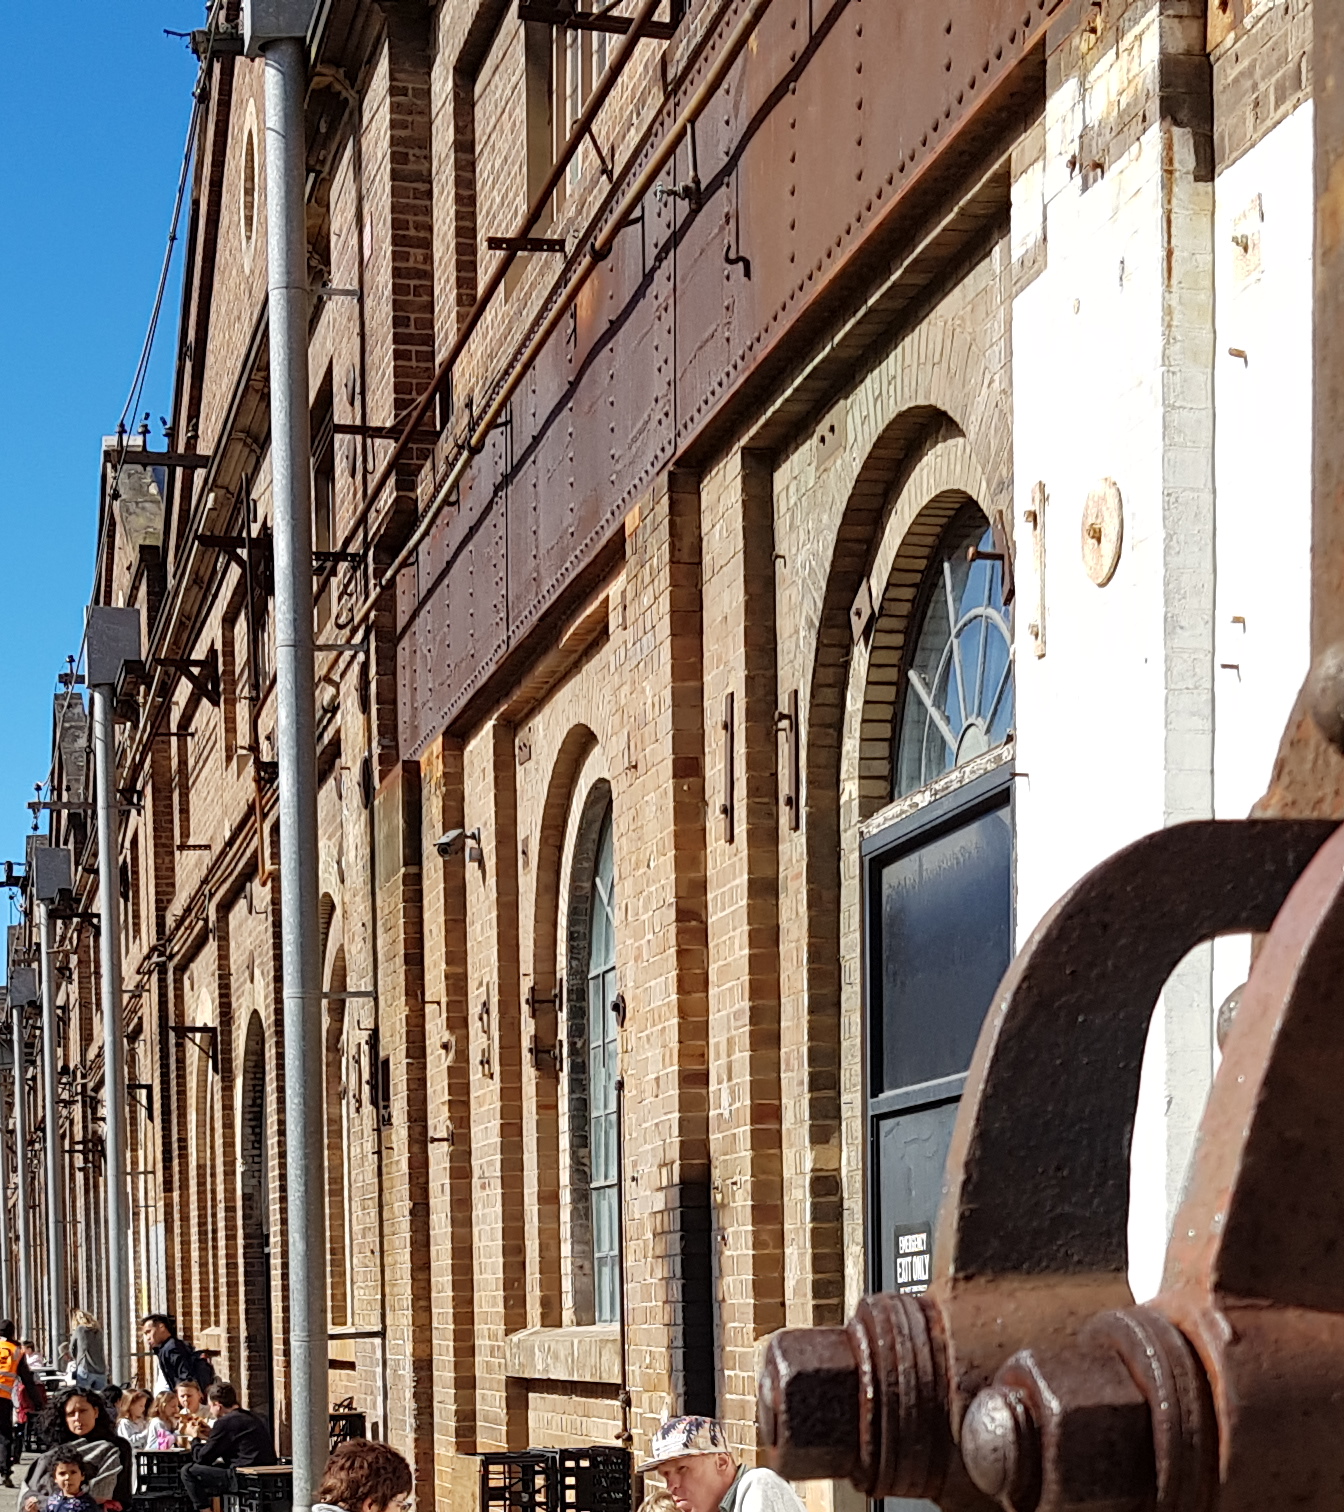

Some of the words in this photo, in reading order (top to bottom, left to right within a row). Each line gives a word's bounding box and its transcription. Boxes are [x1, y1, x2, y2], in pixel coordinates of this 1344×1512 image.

[898, 1233, 927, 1254] EMERGENCY
[897, 1256, 912, 1284] EXIT
[913, 1254, 930, 1281] ONLY
